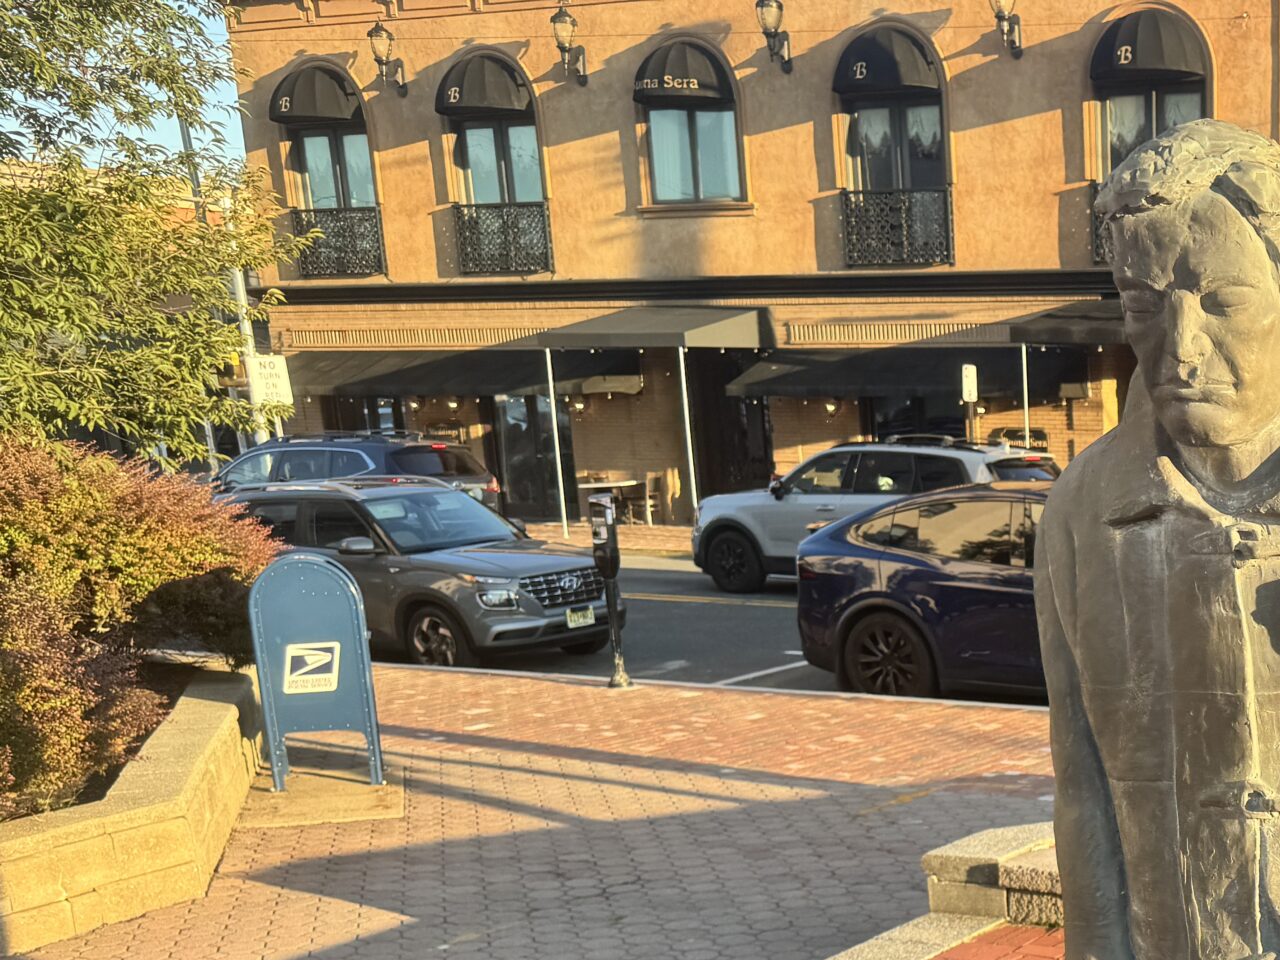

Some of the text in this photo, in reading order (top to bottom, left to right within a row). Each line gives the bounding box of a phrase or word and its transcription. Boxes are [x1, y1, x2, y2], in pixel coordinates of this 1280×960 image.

[1117, 45, 1132, 64] B
[854, 62, 867, 79] B
[663, 75, 699, 90] Sera
[448, 87, 460, 103] B
[280, 97, 290, 112] B
[259, 361, 276, 370] NO
[259, 372, 281, 380] TURN
[265, 383, 278, 391] ON
